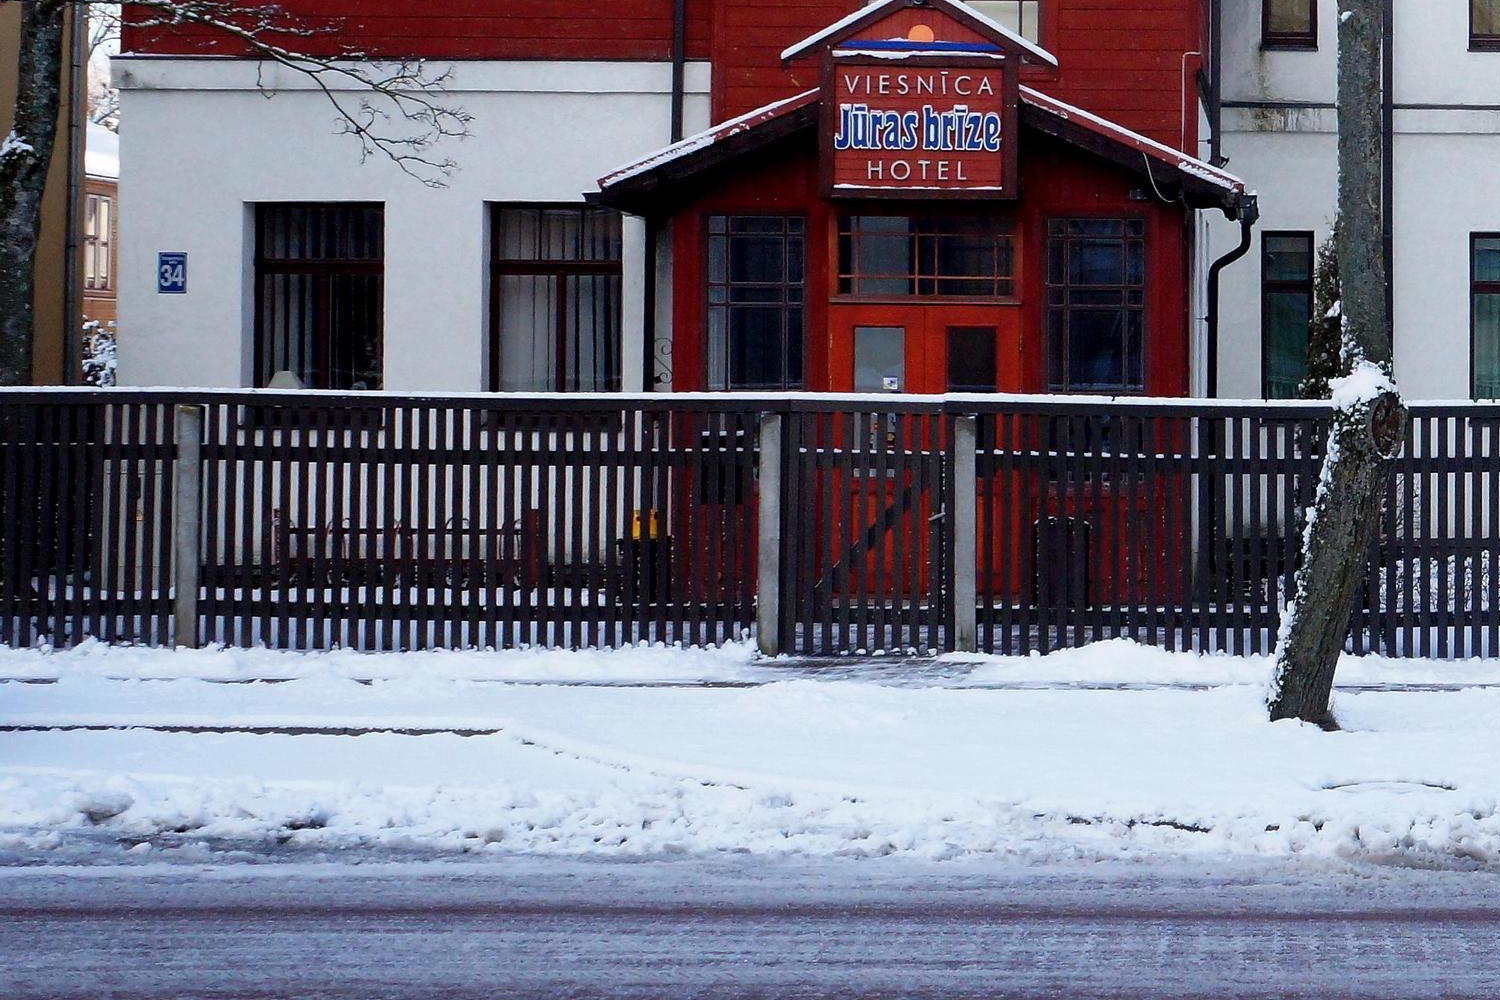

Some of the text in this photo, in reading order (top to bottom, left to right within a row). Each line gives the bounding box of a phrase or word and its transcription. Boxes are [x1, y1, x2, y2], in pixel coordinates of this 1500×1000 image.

[844, 71, 994, 96] VIESNĪCA
[834, 103, 1002, 152] Jūras brīze
[866, 160, 968, 181] HOTEL
[160, 264, 184, 287] 34
